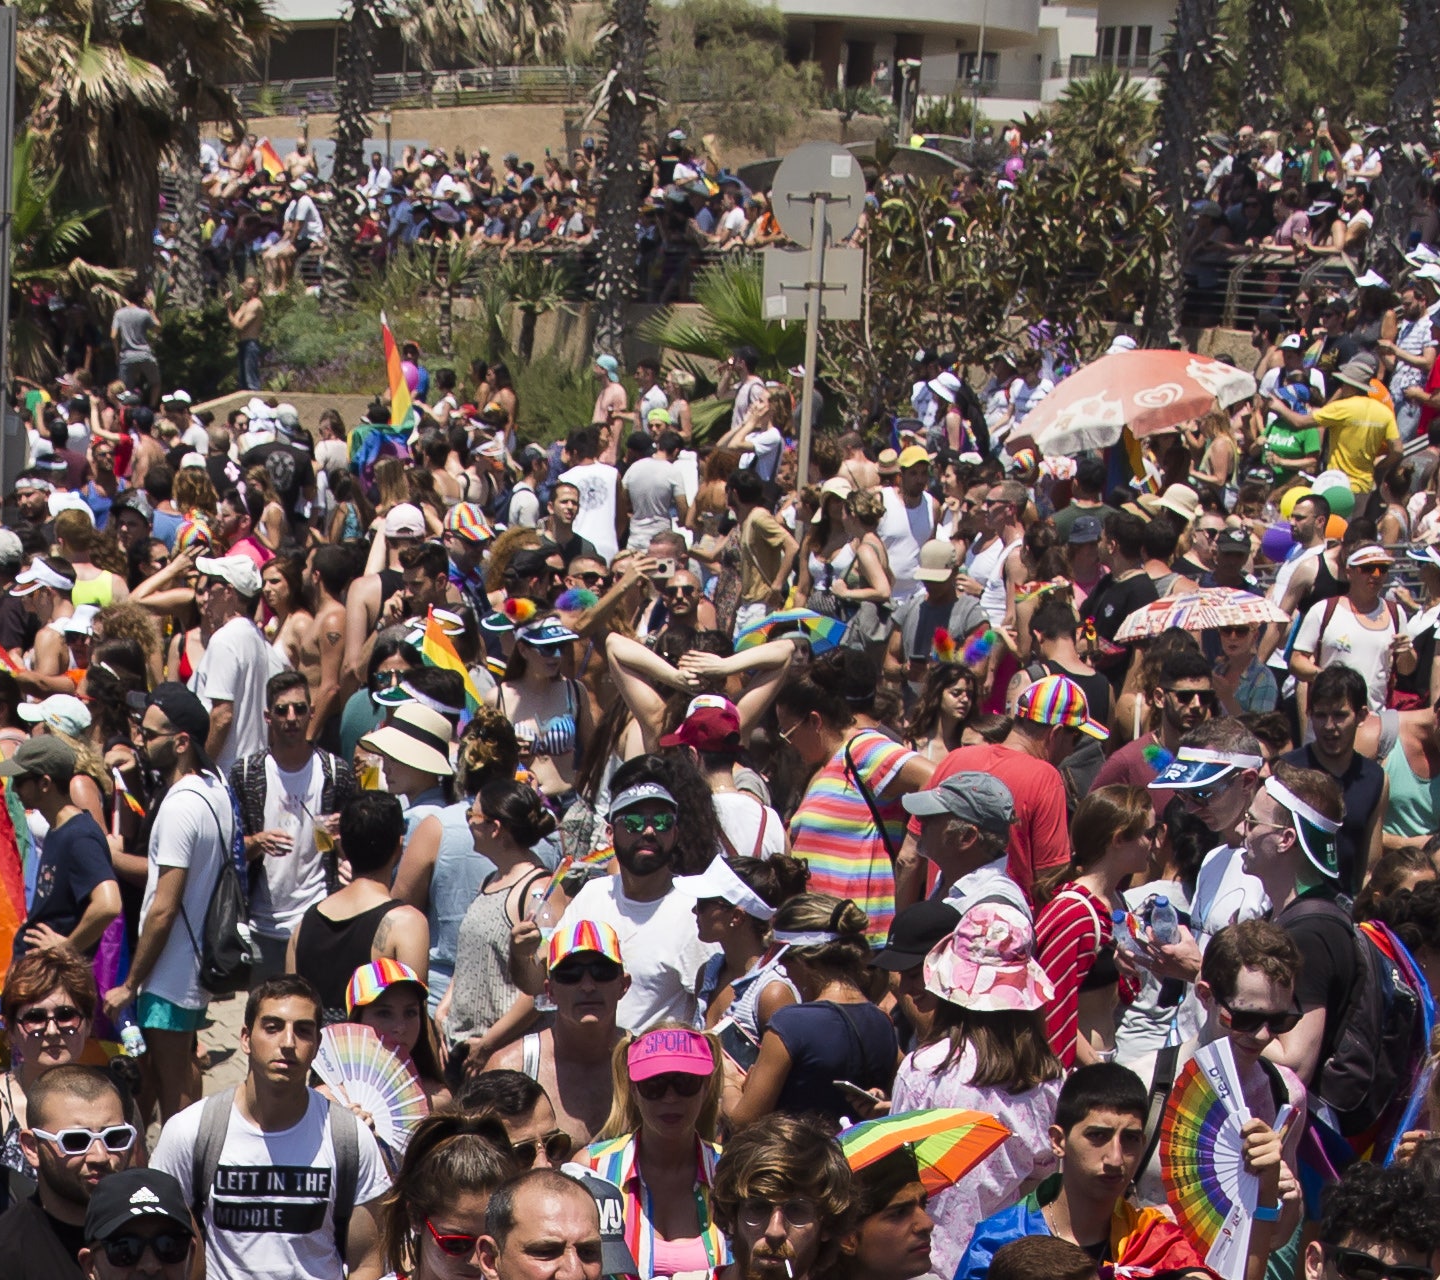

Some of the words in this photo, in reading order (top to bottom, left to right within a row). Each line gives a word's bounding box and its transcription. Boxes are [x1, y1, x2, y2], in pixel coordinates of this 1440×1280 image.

[645, 1030, 696, 1055] SPORT
[217, 1171, 259, 1193] LEFT
[266, 1171, 288, 1193] IN
[295, 1170, 326, 1193] THE
[216, 1208, 283, 1232] MIDDLE
